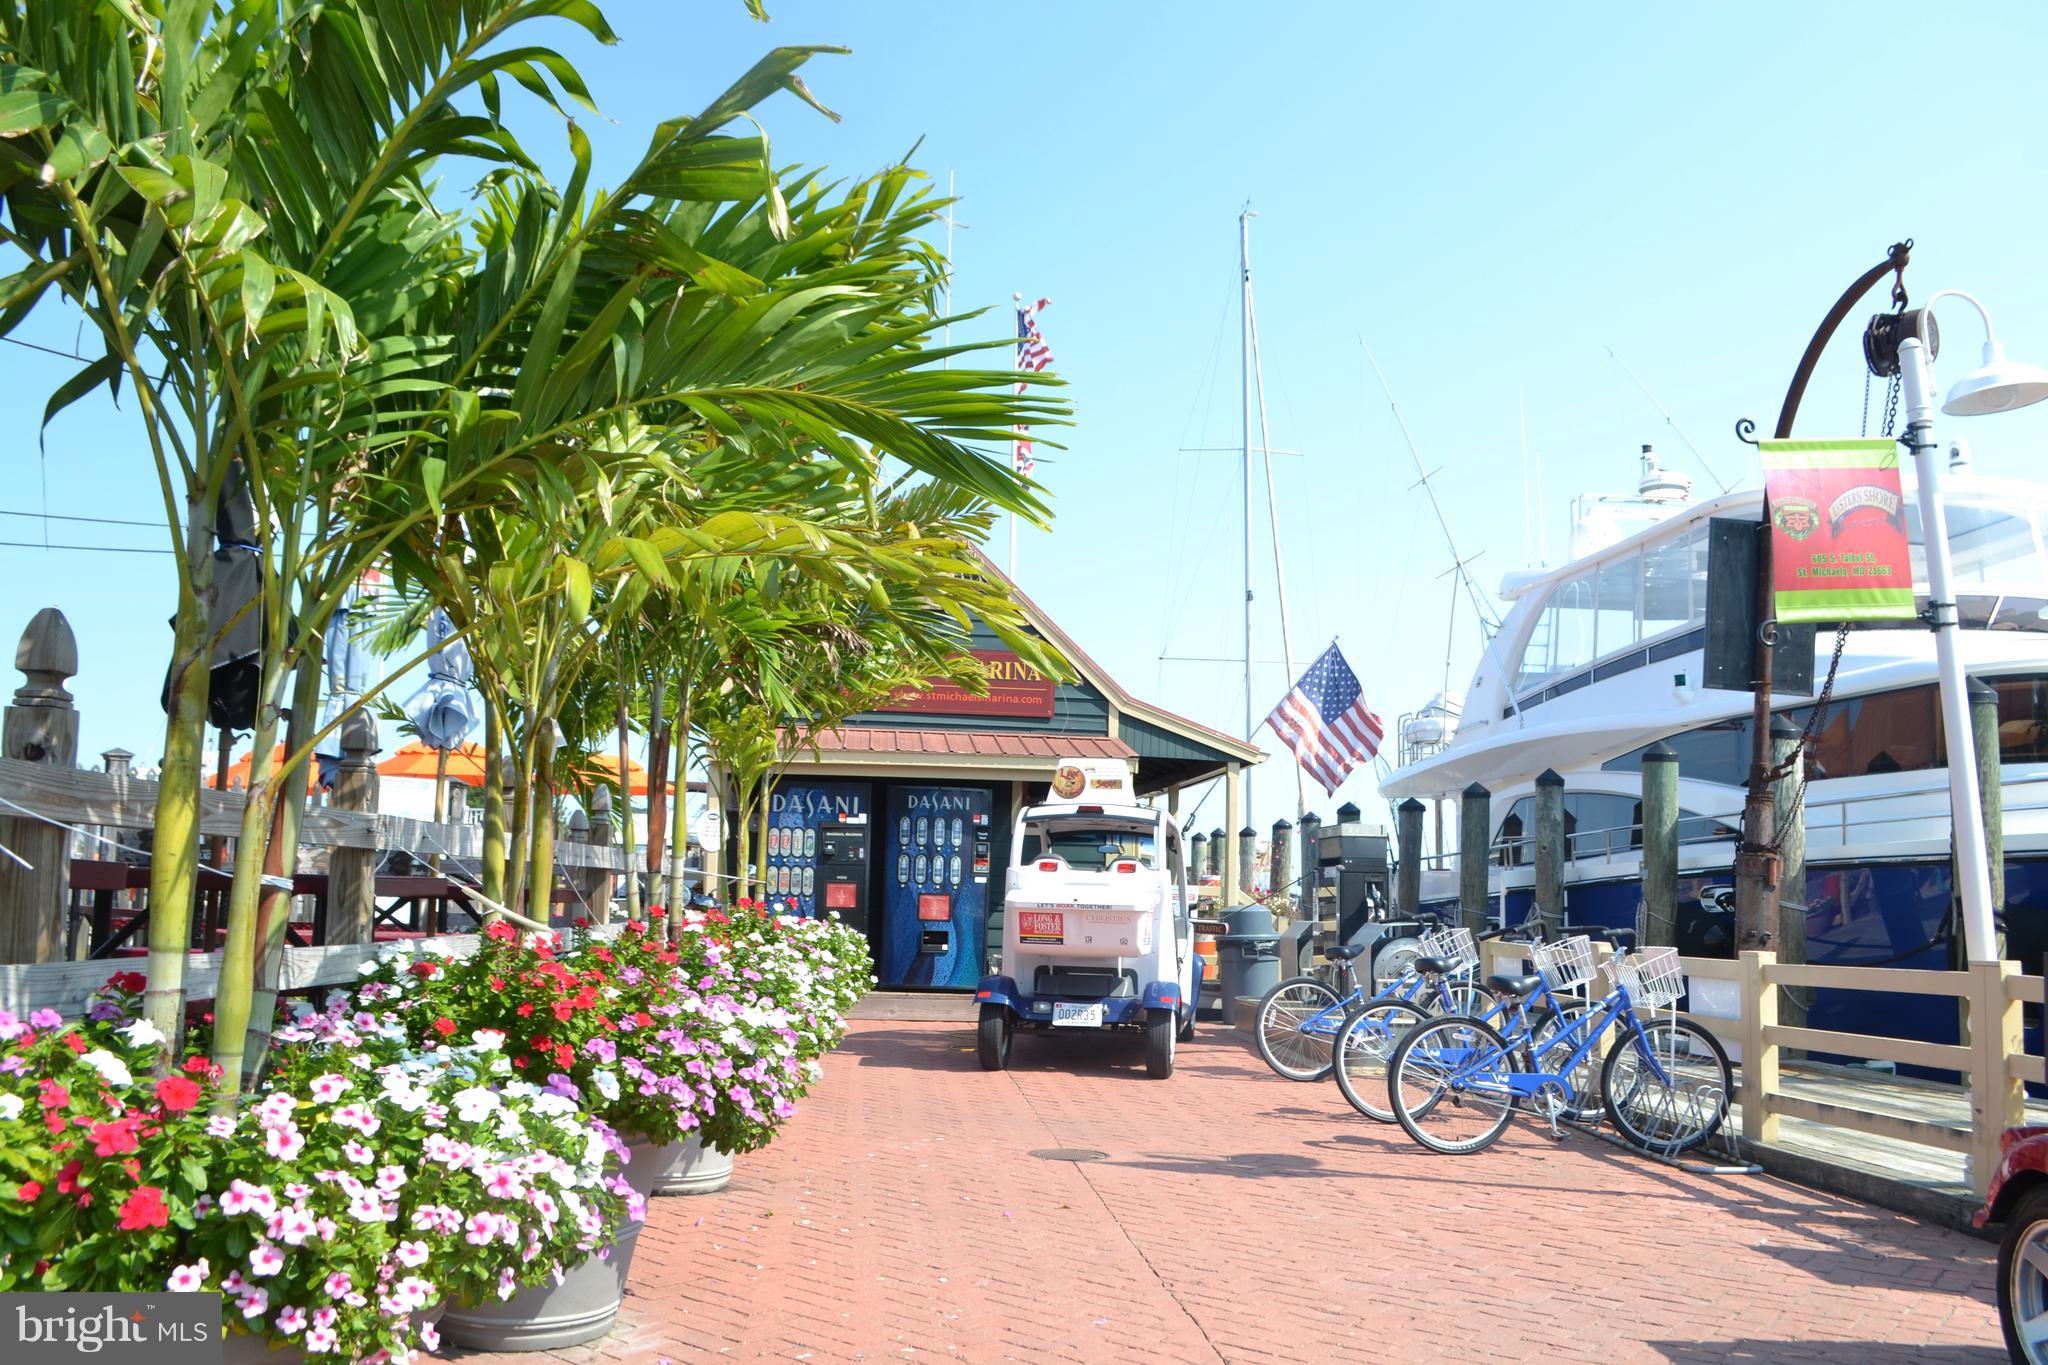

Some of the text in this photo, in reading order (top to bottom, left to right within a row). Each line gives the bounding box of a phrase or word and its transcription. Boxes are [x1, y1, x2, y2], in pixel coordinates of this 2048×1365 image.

[1863, 489, 1895, 513] SHORE
[1840, 553, 1863, 563] Talbot
[1797, 568, 1809, 577] St.
[1853, 566, 1865, 576] MD
[772, 789, 859, 818] DASANI
[908, 792, 970, 813] DASANI
[1034, 913, 1061, 922] LONG &
[1034, 922, 1061, 931] FOSTER
